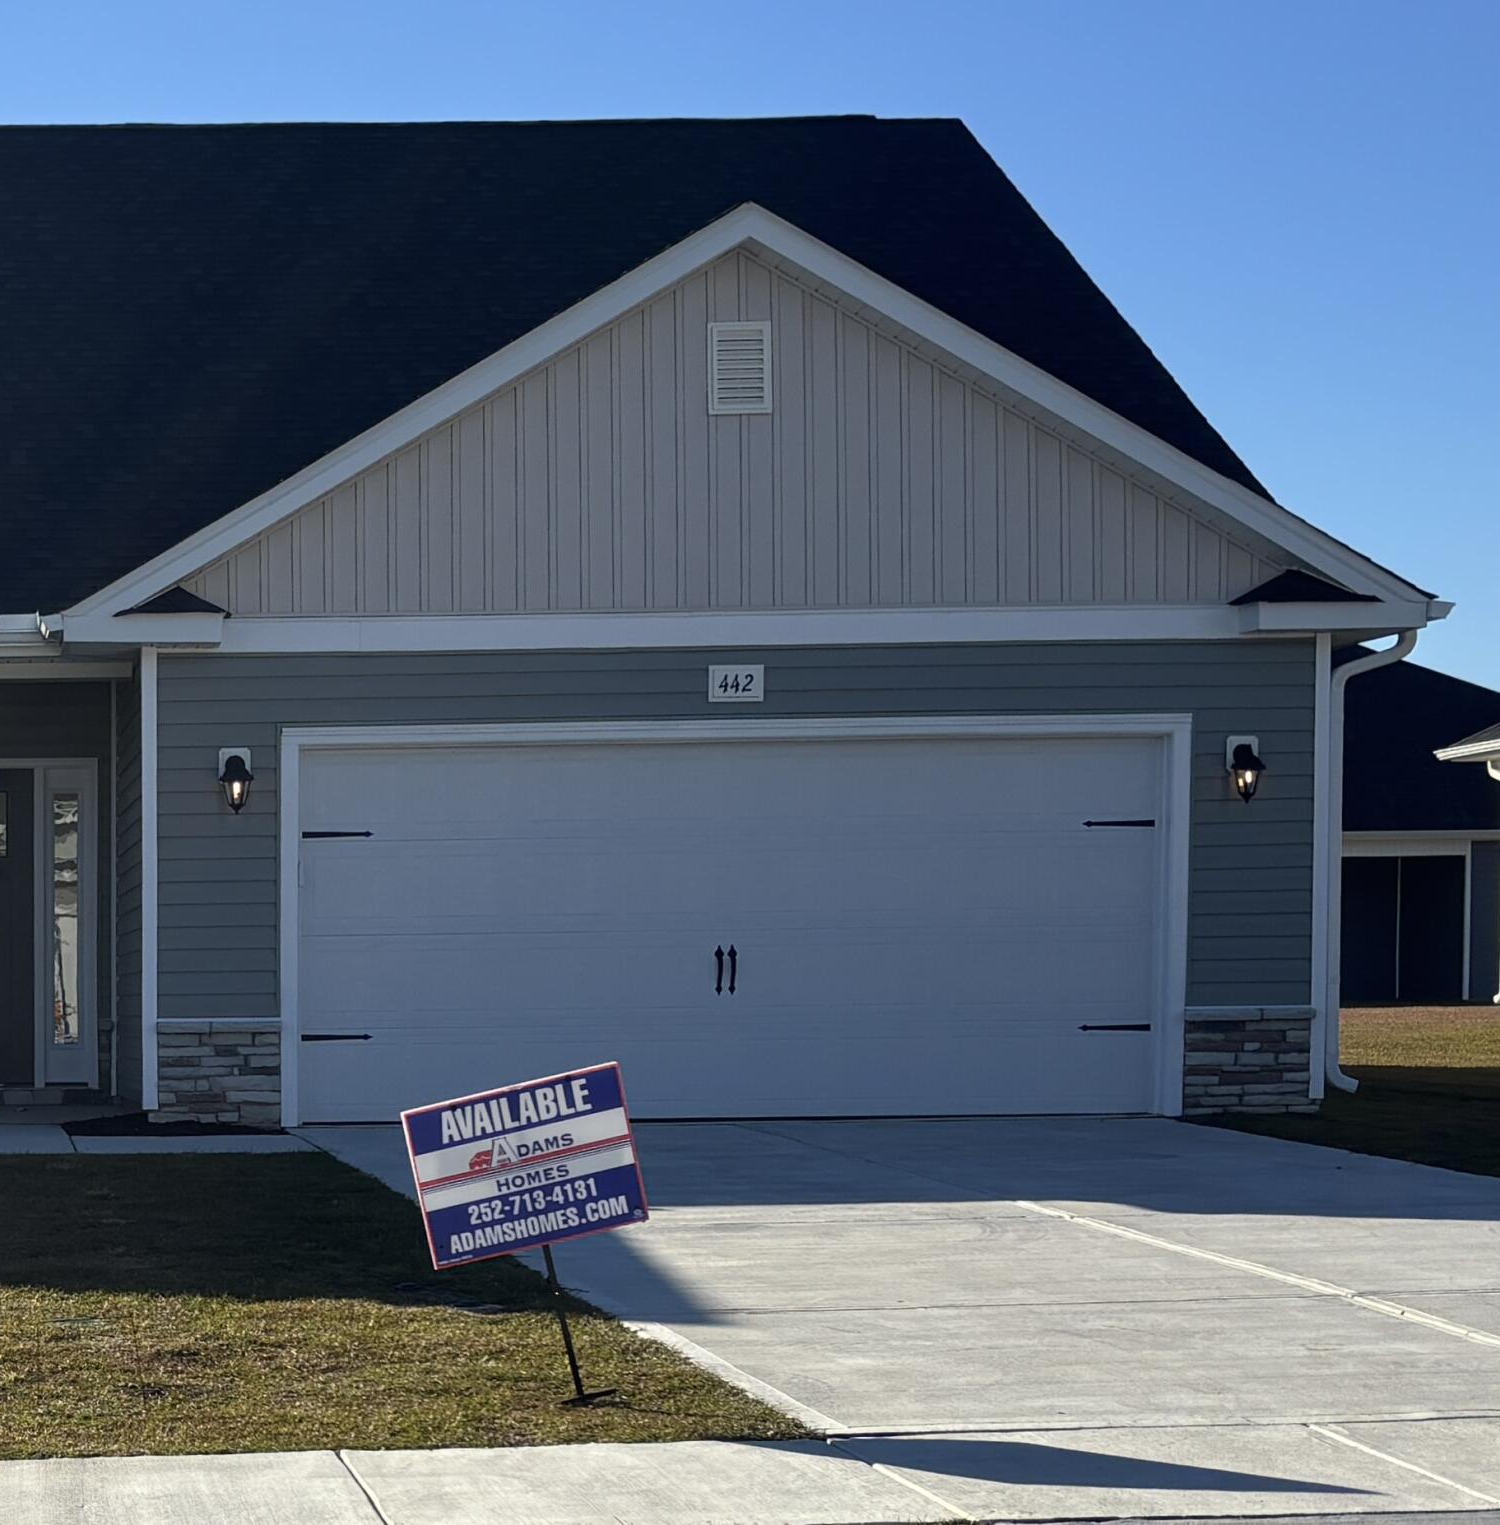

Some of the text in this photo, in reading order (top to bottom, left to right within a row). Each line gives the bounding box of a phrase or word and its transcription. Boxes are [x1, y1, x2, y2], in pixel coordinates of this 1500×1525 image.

[718, 673, 754, 694] 442
[441, 1078, 592, 1144] AVAILABLE
[491, 1133, 574, 1167] ADAMS
[496, 1164, 570, 1192] HOMES
[468, 1178, 598, 1225] 252-713-4131
[451, 1195, 628, 1254] ADAMSHOMES.COM
